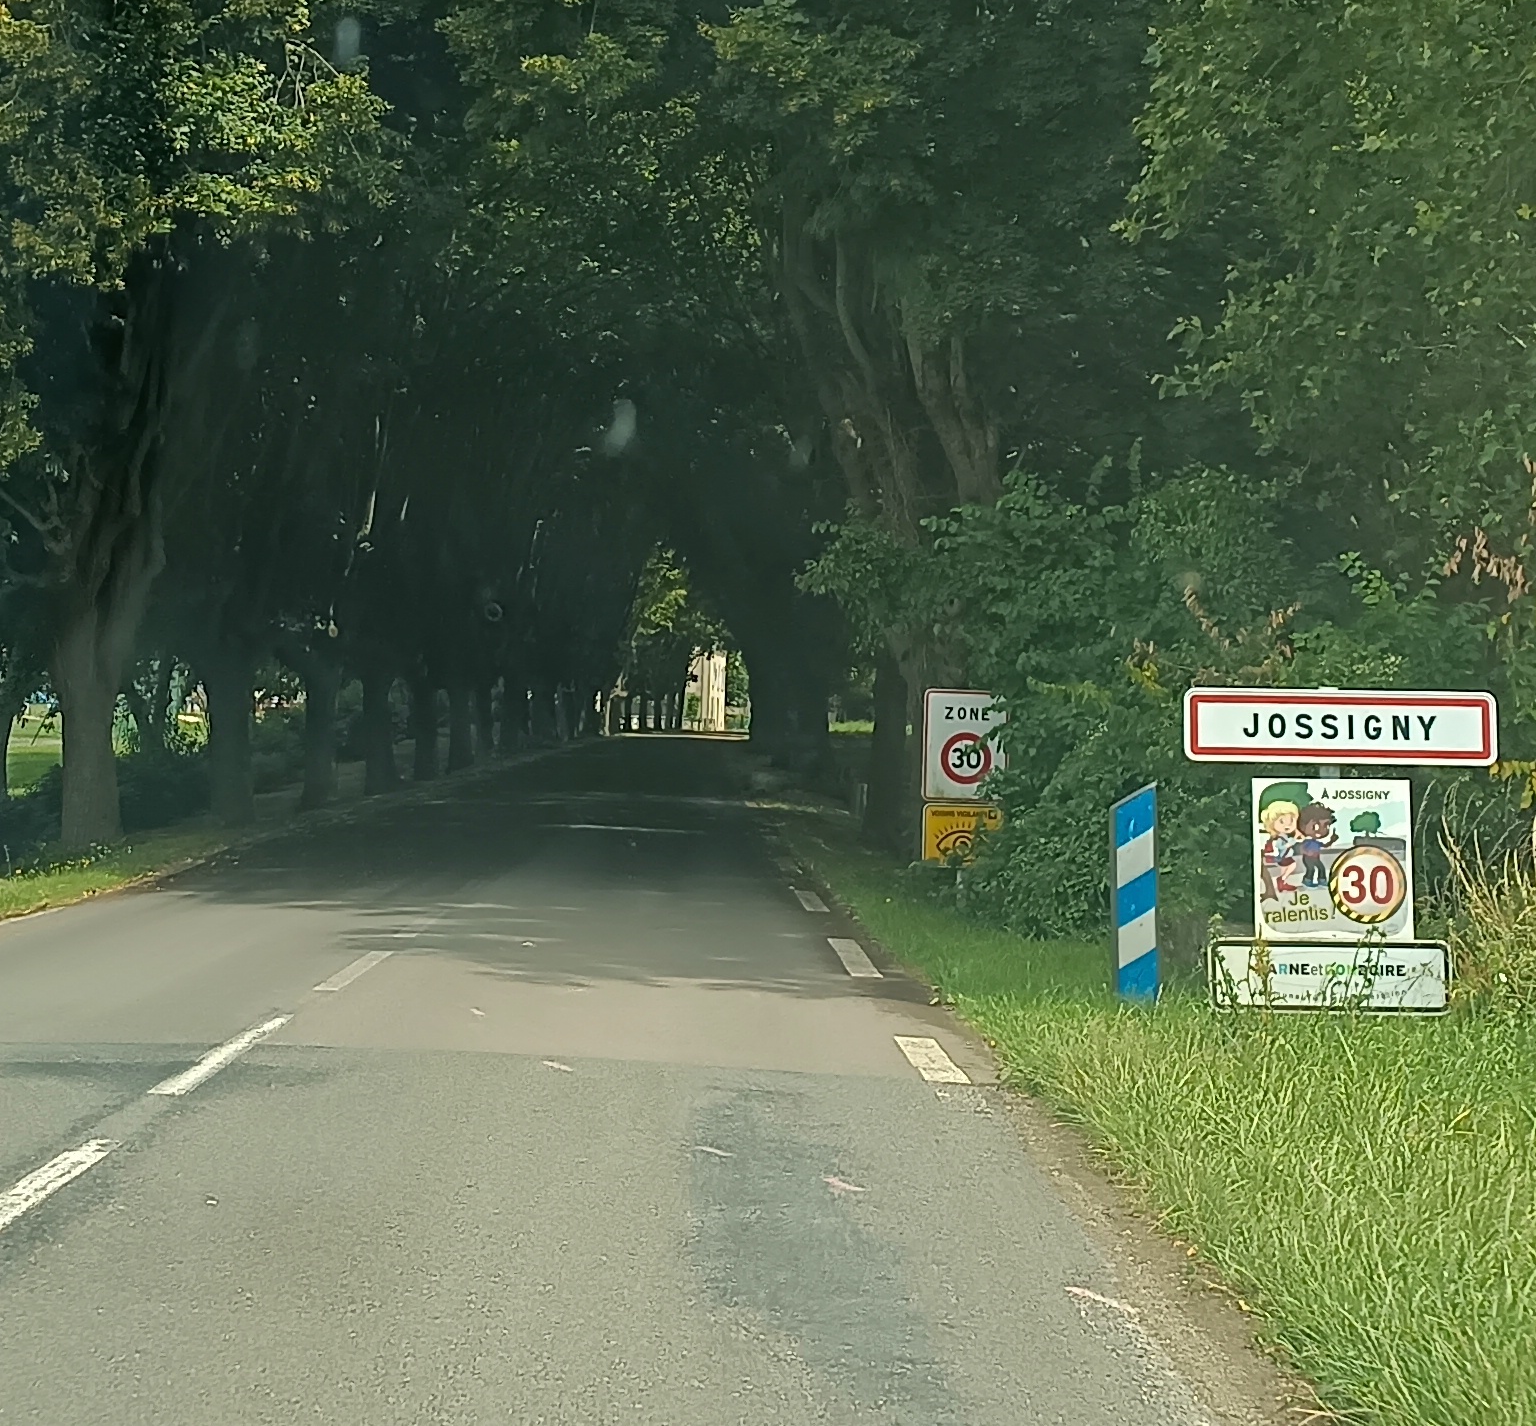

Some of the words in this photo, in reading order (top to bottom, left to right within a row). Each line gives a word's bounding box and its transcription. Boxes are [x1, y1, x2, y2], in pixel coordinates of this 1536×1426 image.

[944, 706, 991, 721] ZONE
[1243, 712, 1437, 741] JOSSIGNY
[951, 747, 981, 769] 30
[1332, 789, 1391, 800] JOSSIGNY
[1342, 865, 1394, 905] 30
[1288, 891, 1310, 906] Je
